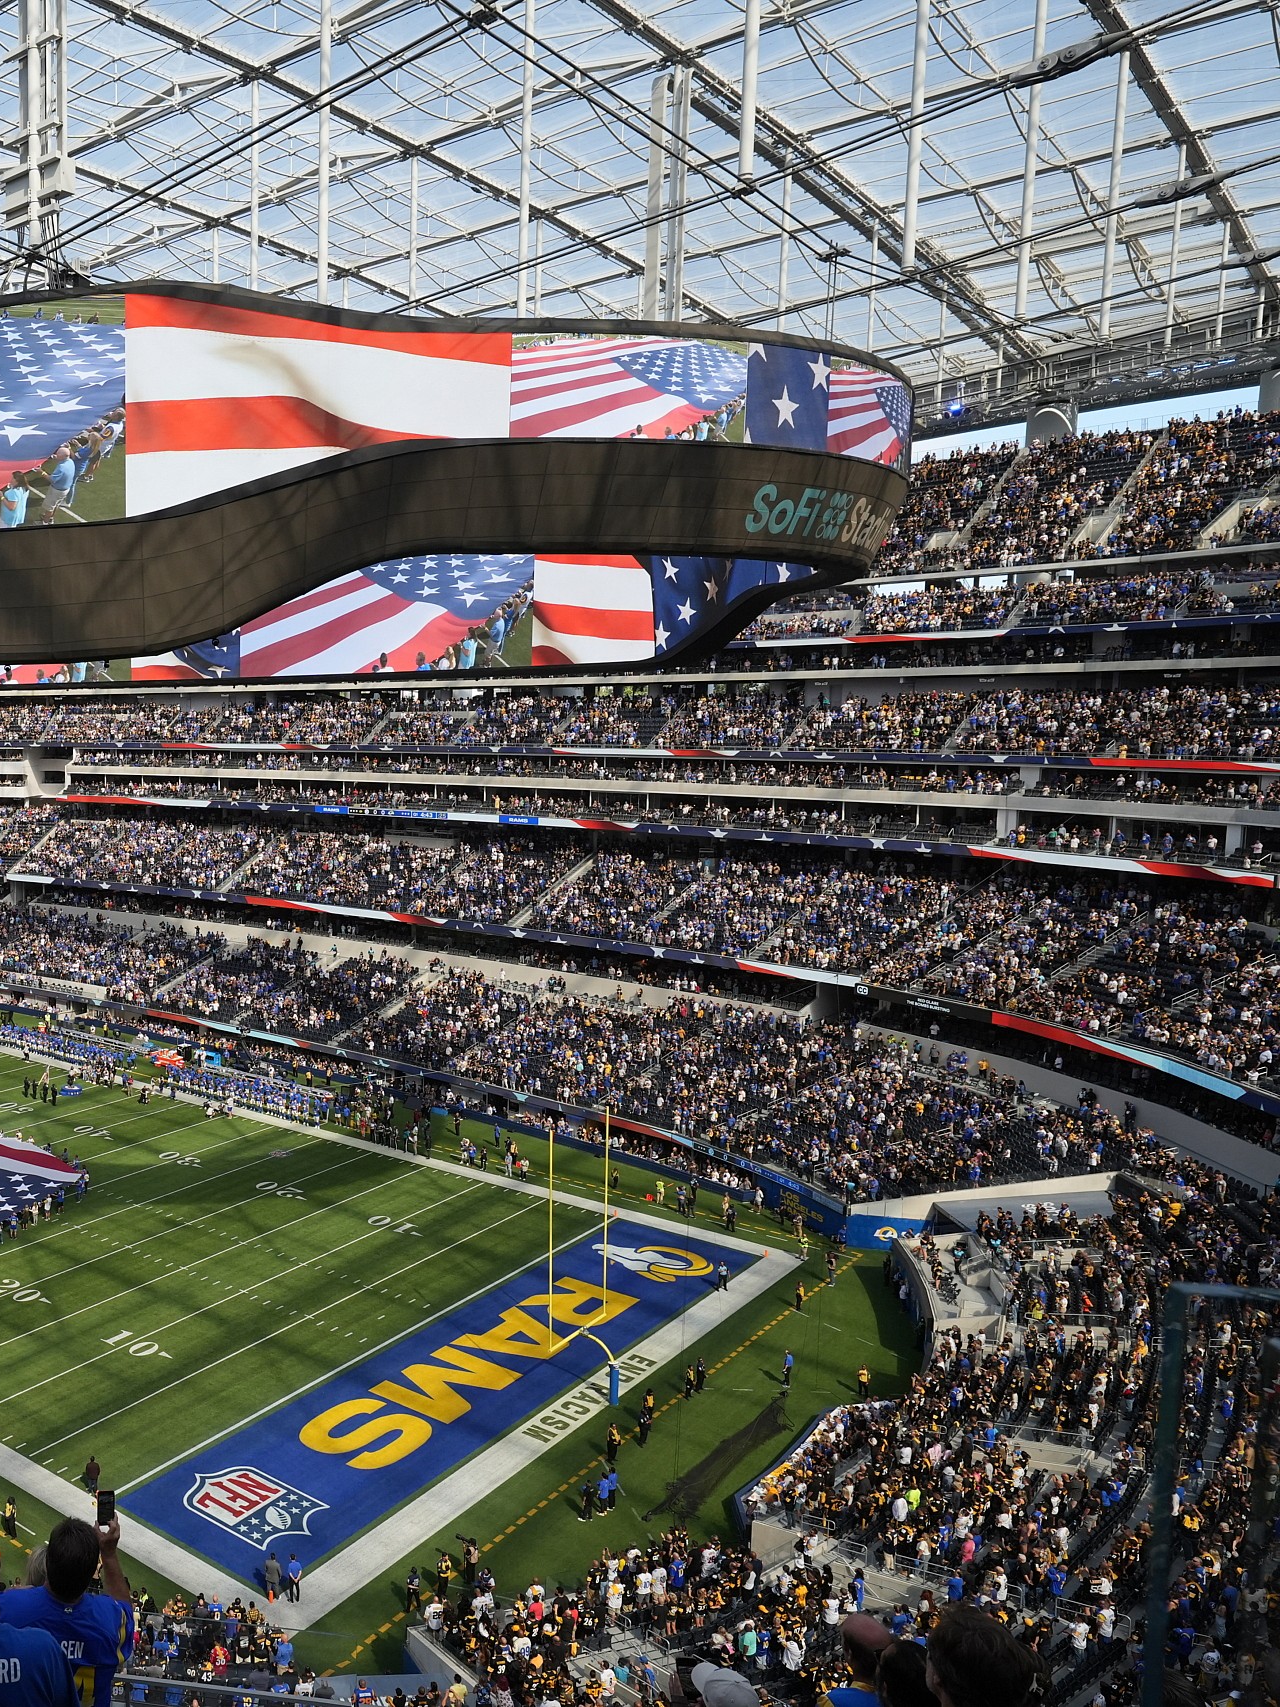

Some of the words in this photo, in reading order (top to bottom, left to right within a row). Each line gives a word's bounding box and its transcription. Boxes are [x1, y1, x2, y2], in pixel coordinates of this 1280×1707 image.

[745, 484, 827, 537] SoFi
[255, 1181, 305, 1199] 20
[780, 1188, 800, 1203] LOS
[367, 1215, 418, 1235] 10
[100, 1330, 159, 1357] 10
[299, 1275, 640, 1470] RAMS
[195, 1472, 281, 1518] NFL
[583, 1616, 593, 1626] 26
[60, 1640, 85, 1659] SEN
[201, 1671, 213, 1682] 43
[497, 1664, 506, 1674] 39
